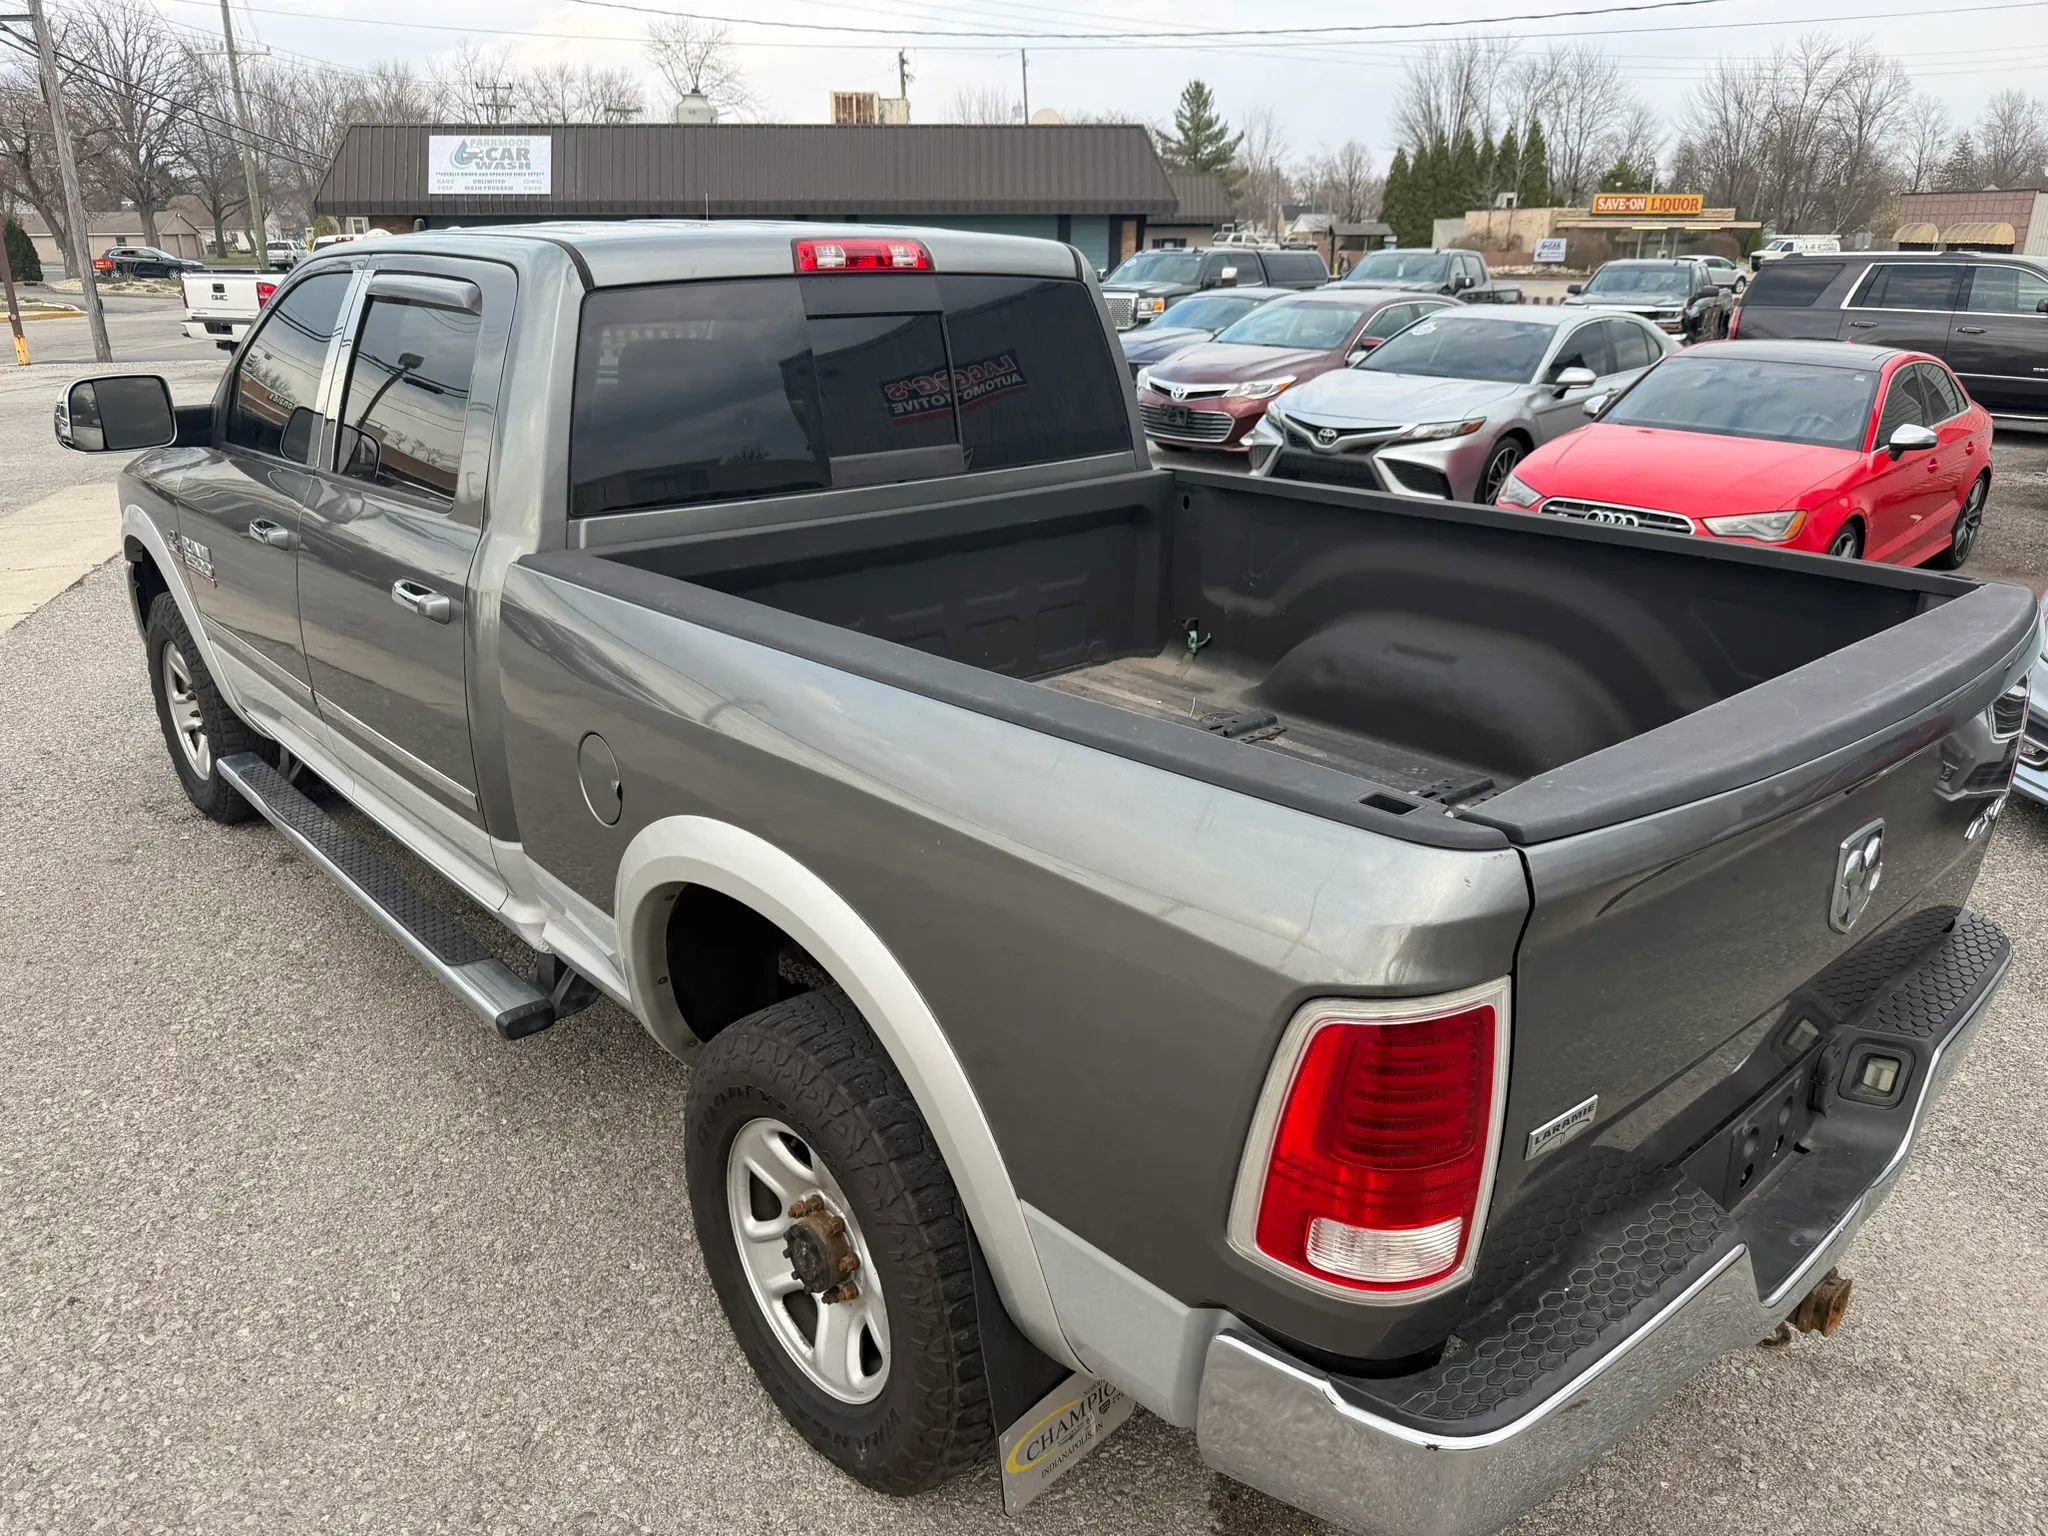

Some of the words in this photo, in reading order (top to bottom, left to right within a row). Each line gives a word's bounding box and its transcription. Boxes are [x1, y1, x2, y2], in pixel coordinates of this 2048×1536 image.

[470, 138, 531, 148] PARKMOOR
[485, 147, 530, 161] CAR
[475, 161, 531, 170] WASH
[1597, 197, 1647, 210] SAVE-ON
[1650, 198, 1699, 212] LIQUOR
[1534, 1102, 1596, 1146] LARAMIE
[1026, 1381, 1117, 1462] CHAMPIO
